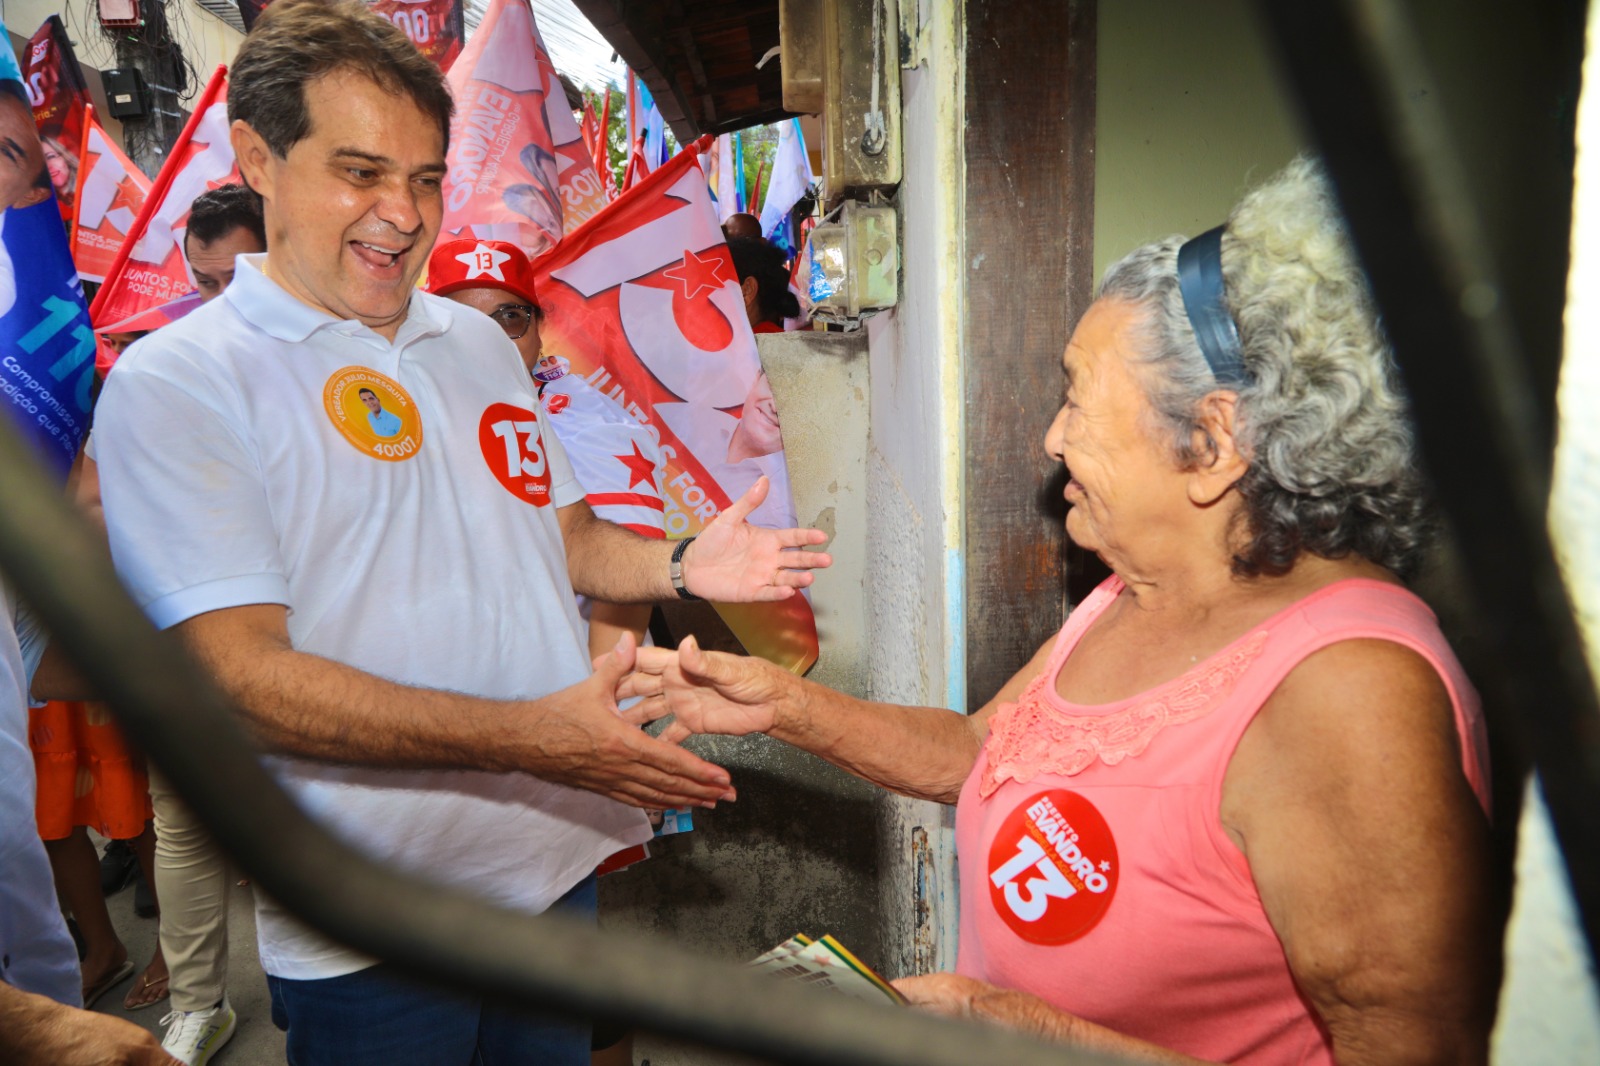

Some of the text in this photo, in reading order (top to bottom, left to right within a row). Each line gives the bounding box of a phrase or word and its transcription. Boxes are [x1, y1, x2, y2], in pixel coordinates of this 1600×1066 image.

[475, 252, 493, 270] 13
[127, 281, 153, 296] PODE
[2, 356, 75, 427] Compromisso
[333, 380, 346, 422] VEREADOR
[367, 376, 407, 407] MESQUITA
[38, 414, 61, 436] que
[373, 435, 416, 457] 40007
[491, 420, 546, 477] 13
[1041, 796, 1079, 842] PREFEITO
[1026, 801, 1108, 893] EVANDRO
[990, 834, 1077, 922] 13
